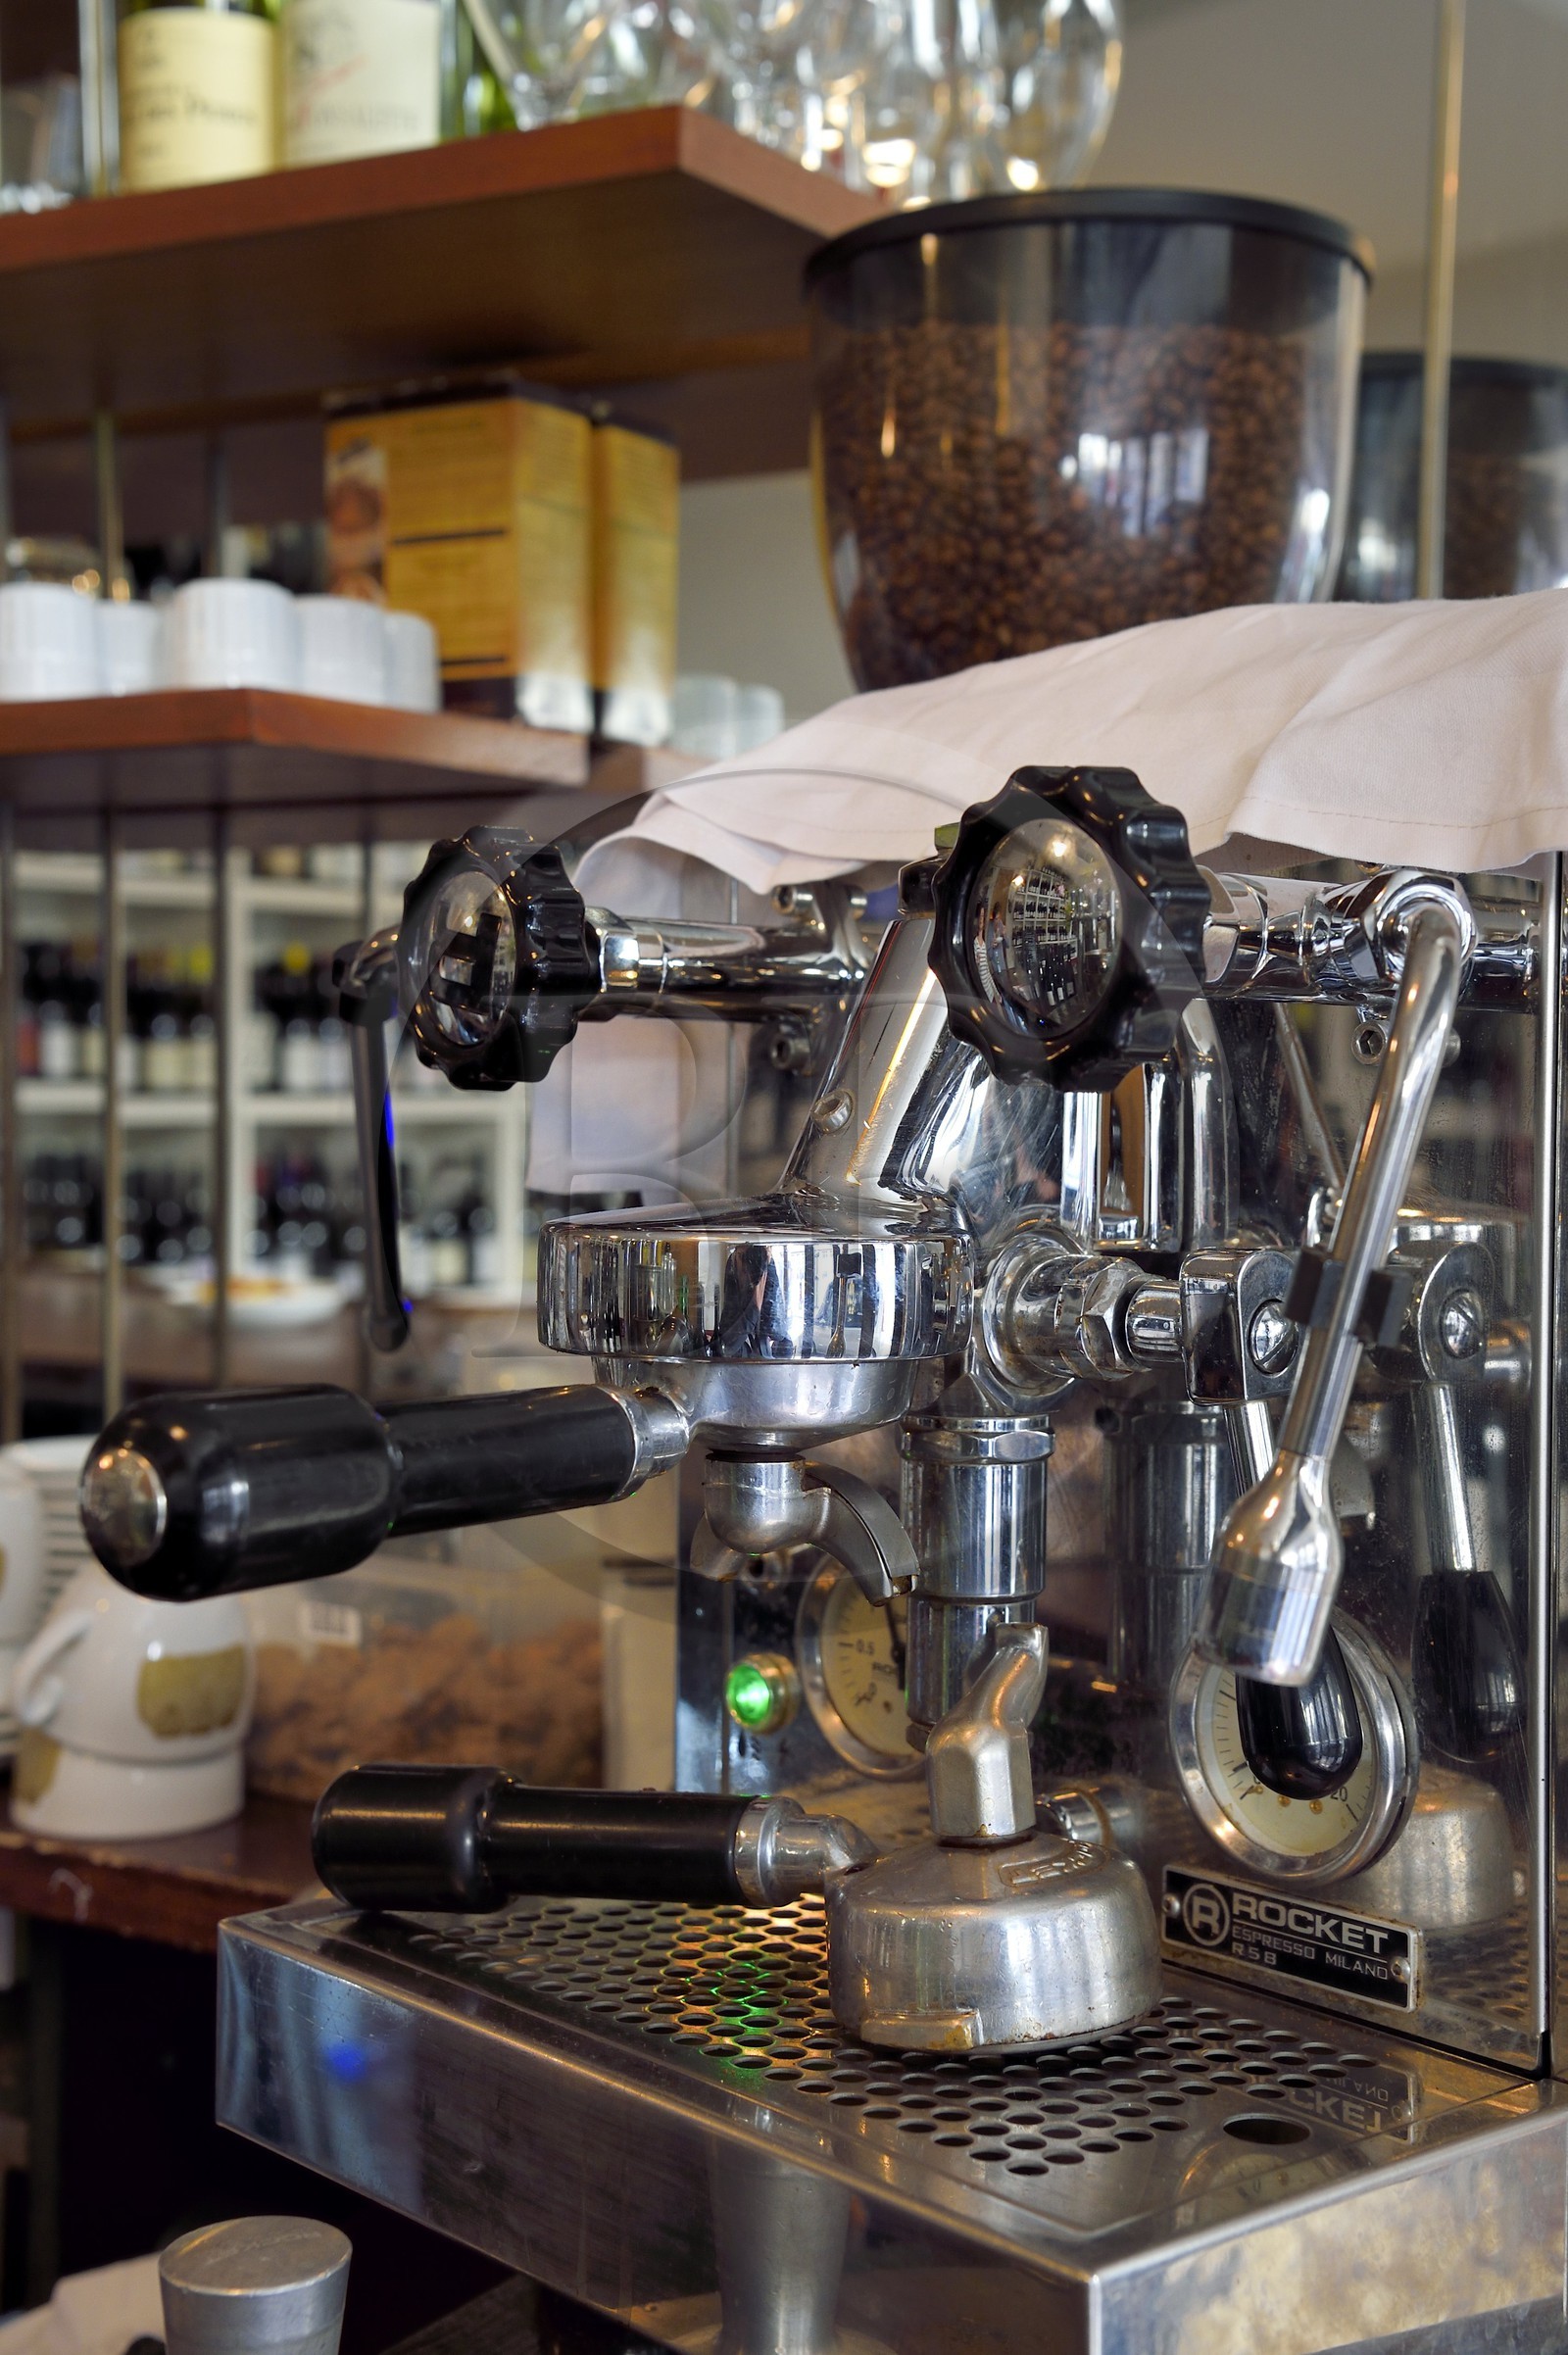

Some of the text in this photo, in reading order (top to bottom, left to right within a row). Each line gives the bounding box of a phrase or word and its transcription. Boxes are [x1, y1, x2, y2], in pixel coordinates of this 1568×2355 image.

[1232, 1892, 1389, 1954] ROCKET
[1232, 1925, 1388, 1981] ESPRESSO MILANO
